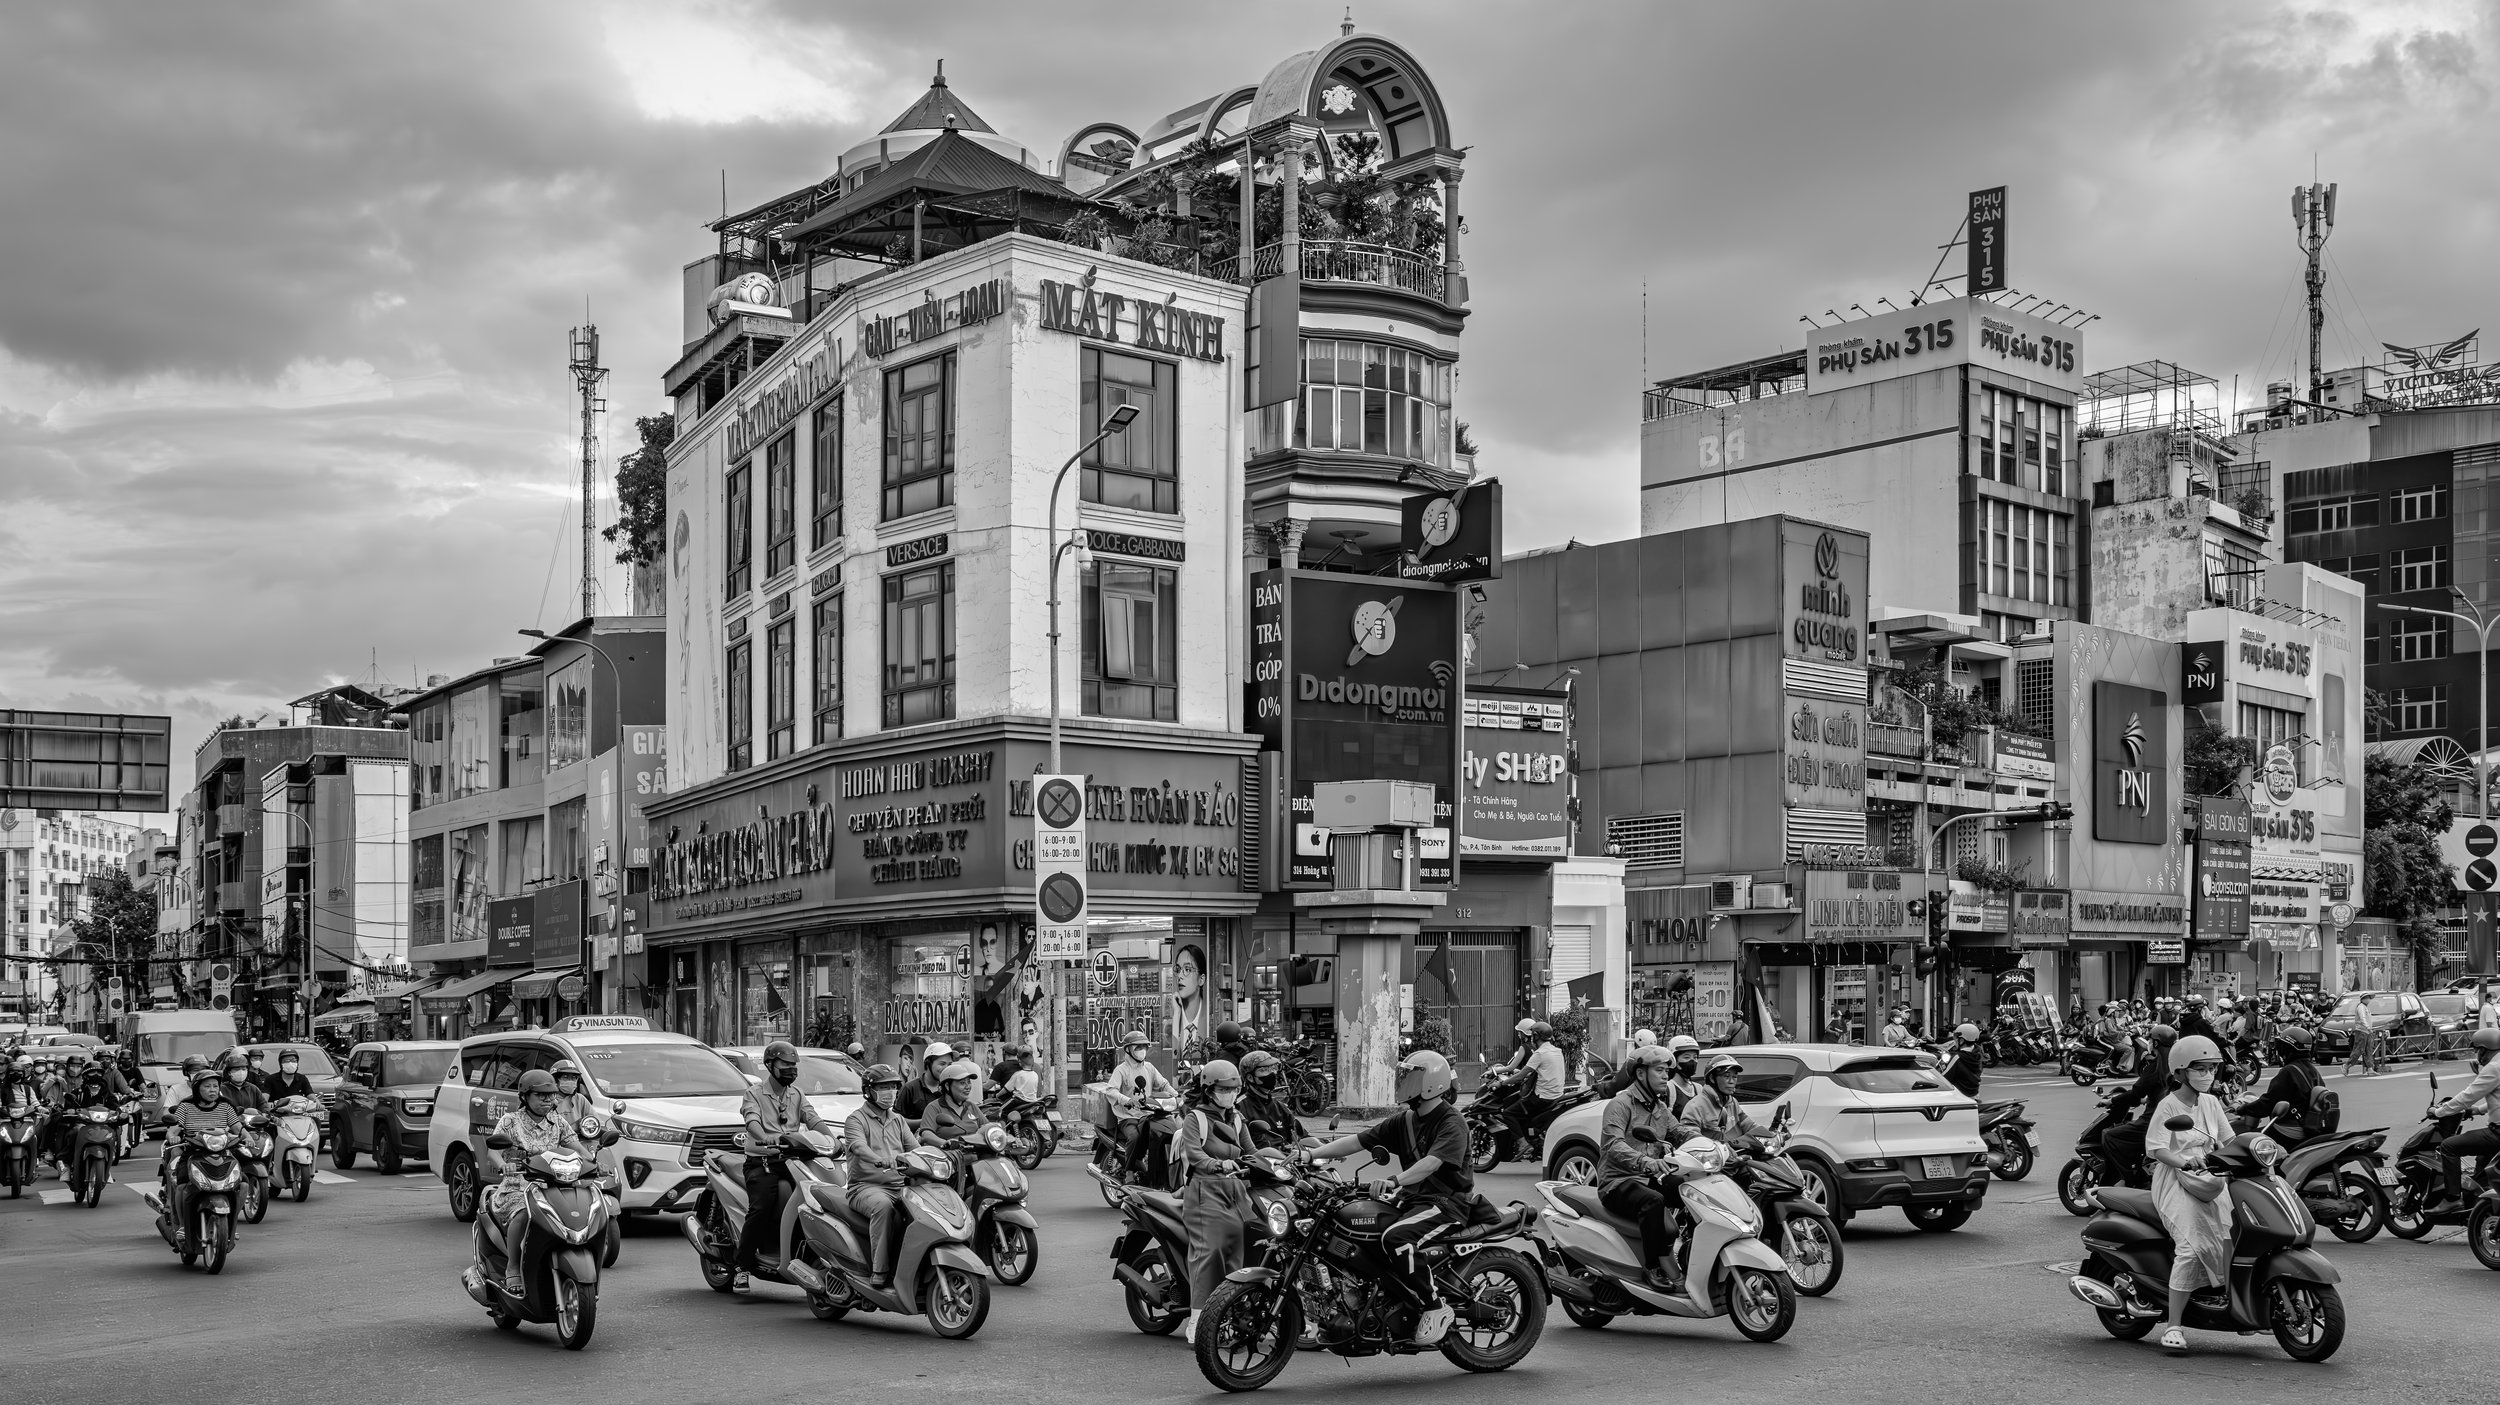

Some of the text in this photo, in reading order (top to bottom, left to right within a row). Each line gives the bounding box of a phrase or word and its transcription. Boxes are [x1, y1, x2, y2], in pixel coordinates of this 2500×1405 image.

[1973, 191, 2002, 208] PHỤ
[1973, 206, 2002, 224] SẢN
[864, 312, 896, 361] CẬN
[960, 278, 1004, 327] LOẠN
[1040, 264, 1225, 363] MẮT KÍNH
[1818, 336, 1864, 353] Phòng khám
[1818, 317, 1954, 374] PHỤ SẢN 315
[1981, 327, 2074, 373] PHỤ SẢN 315
[2384, 367, 2478, 392] VICTORIA
[888, 536, 942, 564] VERSACE
[1087, 530, 1121, 552] DOLCE
[1128, 536, 1184, 560] GABBANA
[812, 567, 838, 594] GUCCI
[1256, 580, 1282, 608] BÁN
[1802, 580, 1851, 618] minh
[1256, 615, 1282, 646] TRẢ
[1794, 618, 1858, 661] quang
[1256, 652, 1282, 682] GÓP
[1825, 650, 1847, 661] mobile
[2240, 642, 2262, 672] PHỤ
[2286, 642, 2311, 678] 315
[1299, 673, 1446, 714] Didongmoi
[2187, 672, 2216, 691] PNJ
[1258, 697, 1281, 718] 0%
[1480, 702, 1498, 712] meiji
[1546, 721, 1562, 729] HiPP
[1792, 703, 1860, 748] SỬA CHỮA
[1496, 751, 1566, 784] SHP
[1788, 754, 1864, 798] ĐIỆN THOẠI
[842, 765, 886, 799] HOAN
[2117, 769, 2151, 818] PNJ
[848, 806, 902, 833] CHUYÊN
[950, 793, 986, 823] PHỐI
[1085, 774, 1128, 822] ÍNH
[1130, 778, 1190, 824] HOÀN
[1194, 779, 1238, 827] HẢO
[1292, 795, 1314, 814] ĐIỆN
[1482, 796, 1500, 805] Chính
[1474, 810, 1486, 819] Cho
[1488, 811, 1497, 820] Mẹ
[1500, 812, 1504, 820] &
[1517, 812, 1535, 822] Người
[1536, 812, 1548, 821] Cao
[2204, 810, 2248, 832] SÀI GÒN SỐ
[2290, 809, 2314, 844] 315
[946, 831, 968, 852] TY
[1044, 835, 1076, 845] 6:00-9:00
[1421, 839, 1446, 847] SONY
[1512, 844, 1530, 852] Hotline:
[1041, 848, 1080, 858] 16:00-20:00
[1126, 838, 1166, 874] KHÚC
[1170, 846, 1190, 879] XẠ
[1194, 846, 1214, 876] BV
[1218, 847, 1238, 876] SG
[1293, 865, 1320, 878] 314 Hoàng
[1431, 868, 1440, 878] 391
[1440, 868, 1450, 878] 333
[1848, 872, 1902, 892] MINH QUANG
[1456, 907, 1472, 918] 312
[1810, 900, 1840, 926] LINH
[498, 924, 531, 941] DOUBLE COFFEE
[1043, 928, 1081, 940] 9:00 16:00
[1642, 917, 1710, 950] THOẠI
[1043, 942, 1081, 952] 20:00 6:00
[884, 994, 910, 1034] BÁC
[922, 1000, 944, 1034] ĐO
[1130, 996, 1148, 1008] THEO
[584, 1018, 643, 1027] VINASUN TAXI
[1087, 1010, 1126, 1050] BÁC
[1350, 1217, 1376, 1226] YAMAHA
